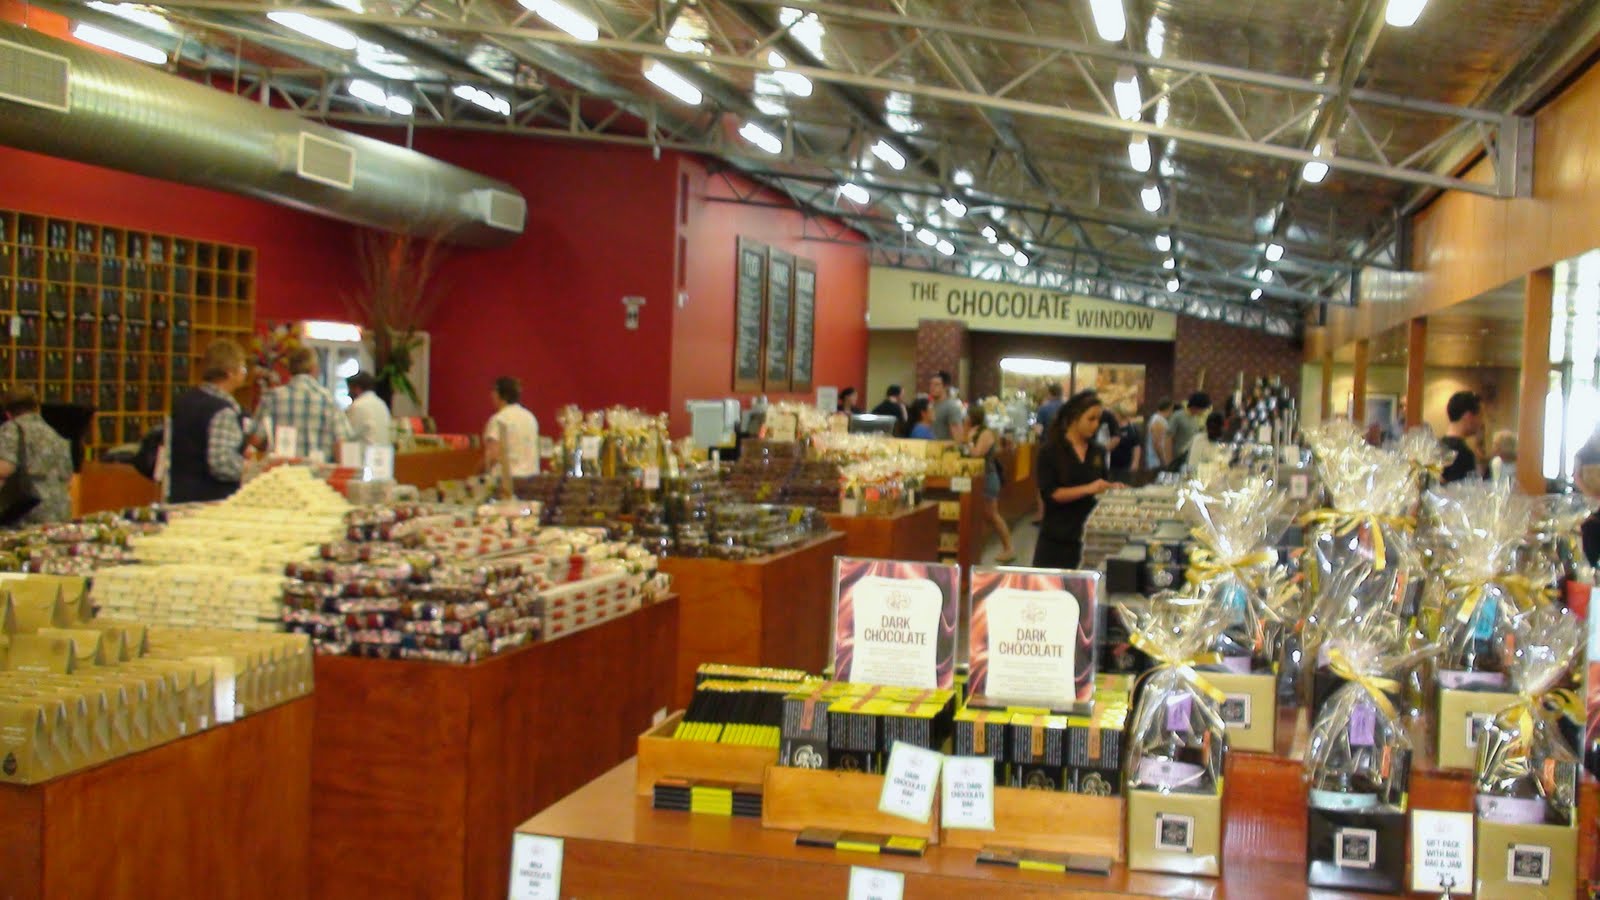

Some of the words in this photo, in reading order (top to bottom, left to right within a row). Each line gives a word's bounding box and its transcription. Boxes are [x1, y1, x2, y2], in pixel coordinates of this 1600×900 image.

[910, 281, 939, 302] THE
[946, 288, 1073, 321] CHOCOLATE
[1076, 308, 1155, 331] WINDOW
[881, 614, 911, 630] DARK
[864, 627, 928, 646] CHOCOLATE
[1016, 627, 1047, 643] DARK
[999, 640, 1064, 659] CHOCOLATE
[893, 777, 927, 792] CHOCOLATE
[951, 791, 984, 799] CHOCOLATE
[1442, 840, 1460, 848] PACK
[1426, 849, 1444, 857] WITH
